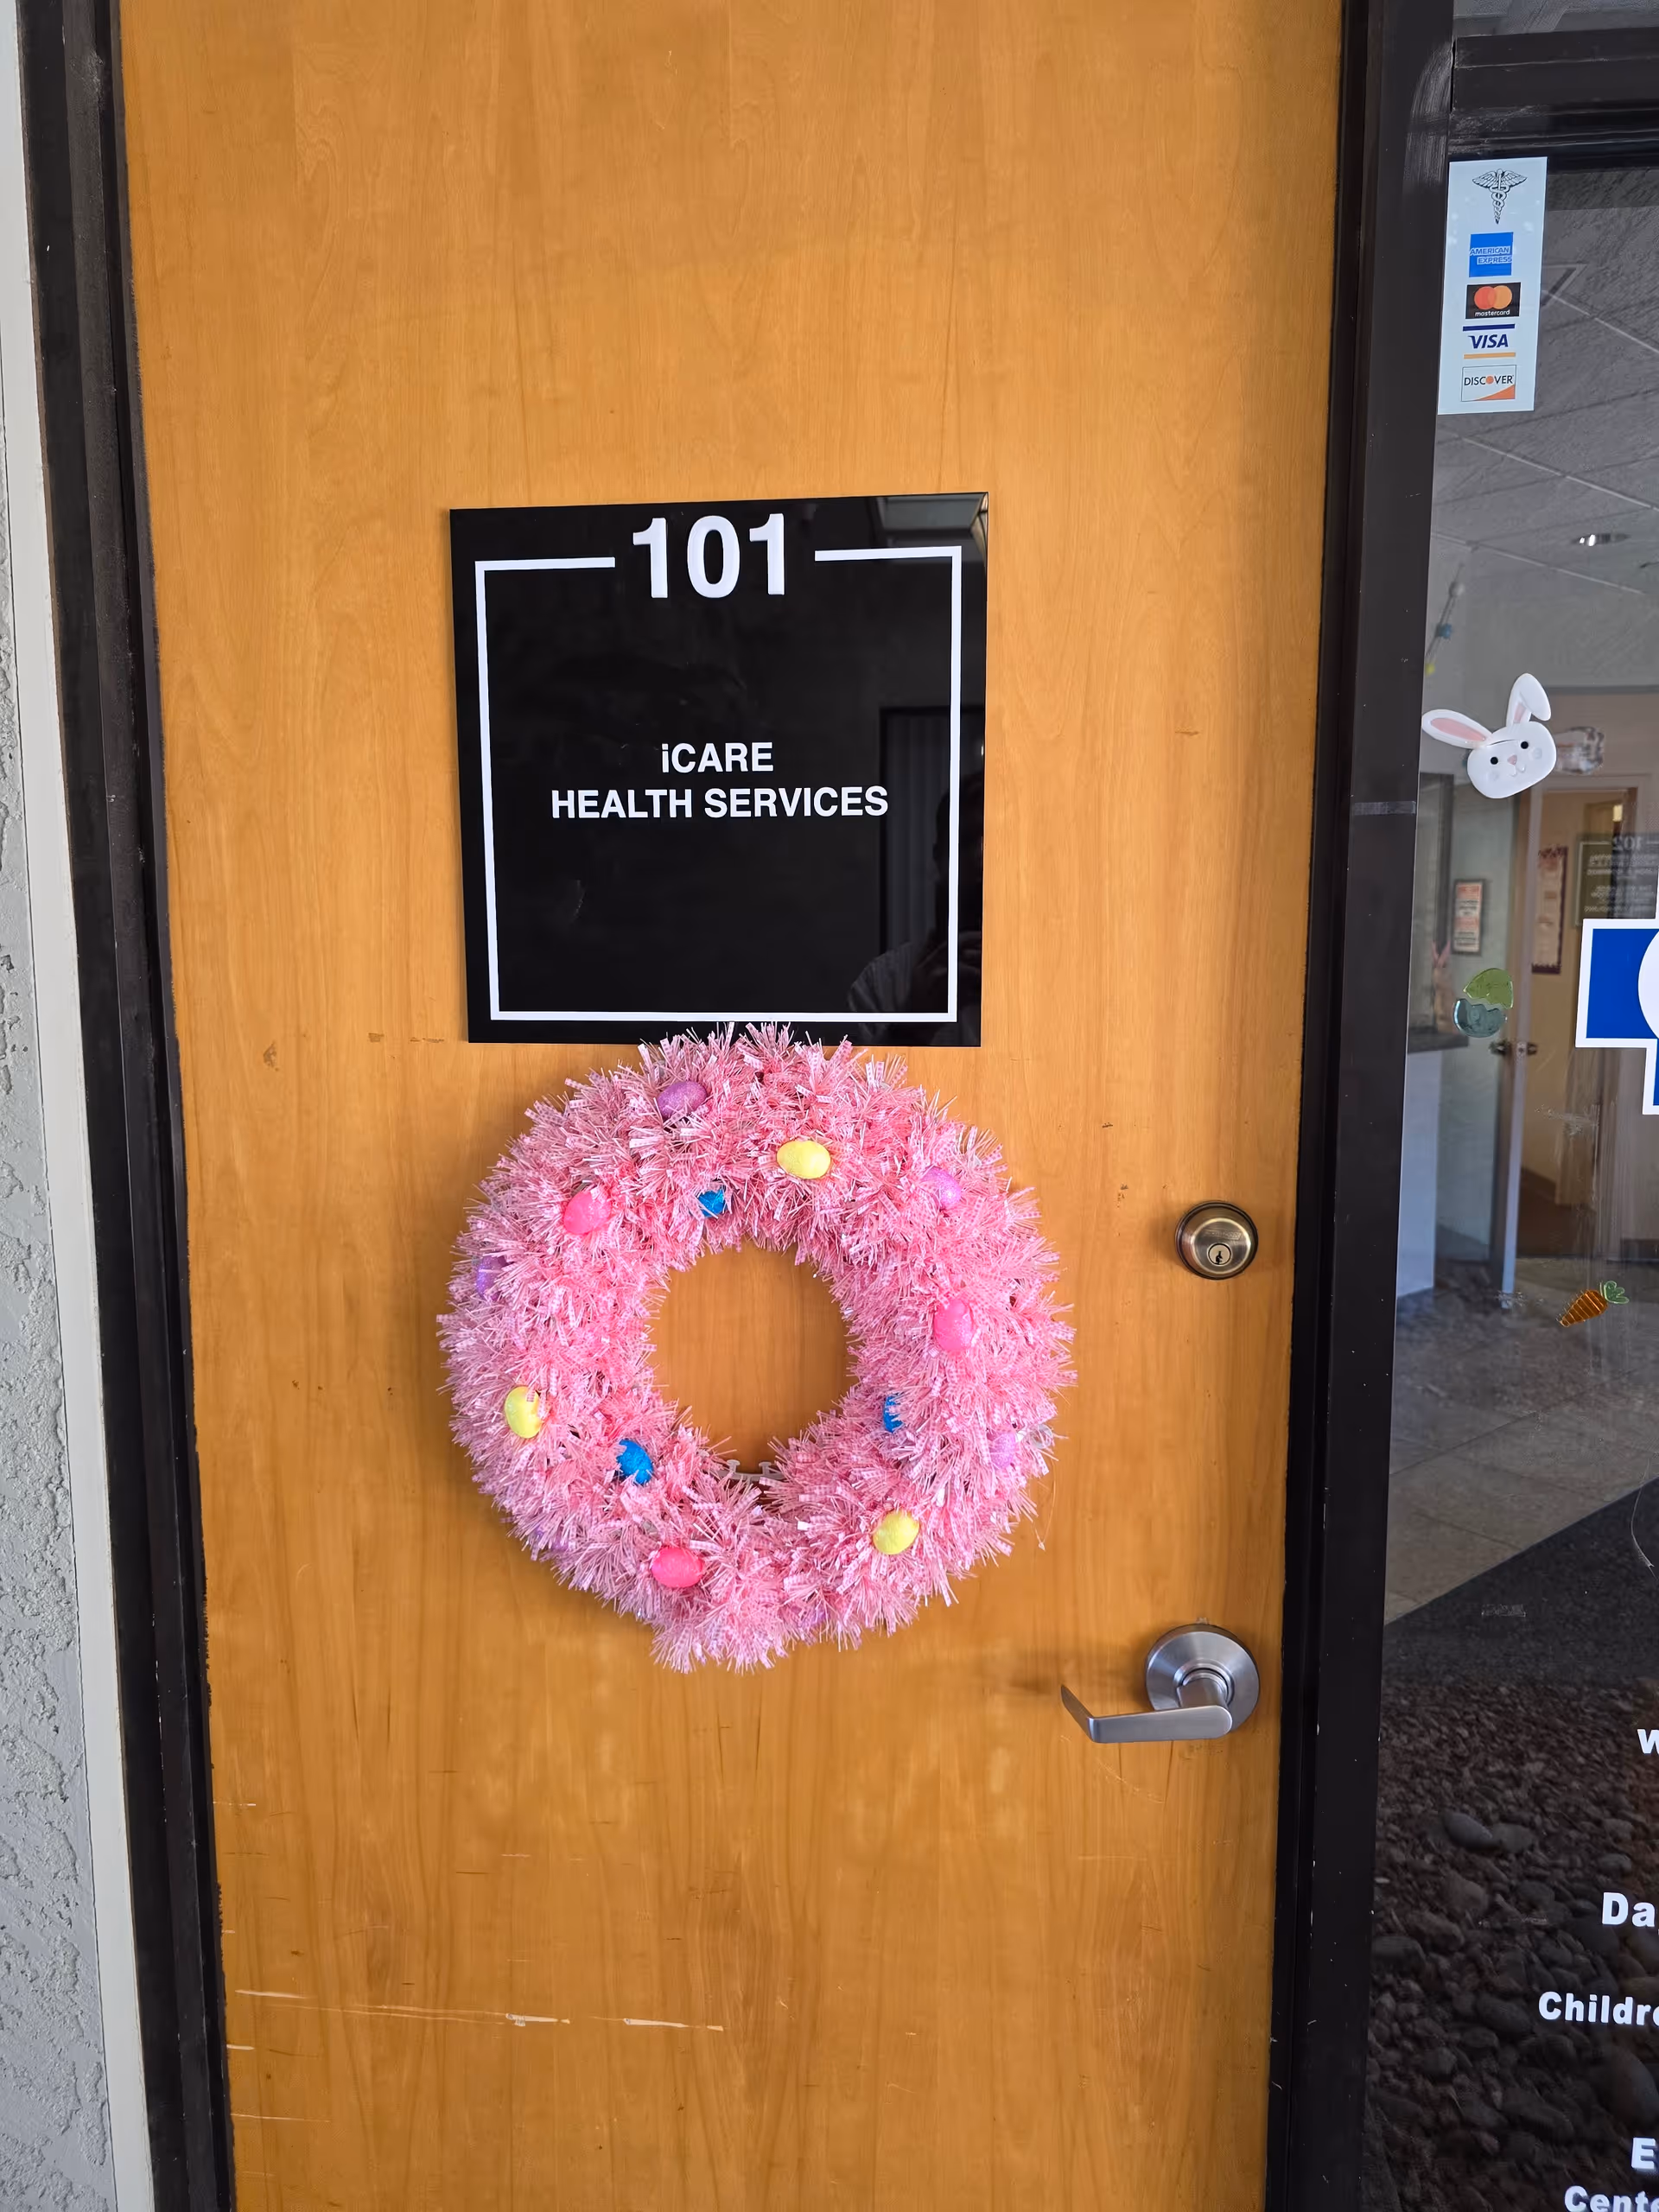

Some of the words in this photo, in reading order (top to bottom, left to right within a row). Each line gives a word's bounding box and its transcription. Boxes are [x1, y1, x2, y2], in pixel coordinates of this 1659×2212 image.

[1470, 246, 1510, 256] AMERICAN
[1477, 256, 1512, 264] EXPRESS
[1467, 334, 1509, 349] VISA
[1464, 375, 1514, 386] DISCOVER
[632, 512, 785, 599] 101
[661, 741, 774, 773] iCARE
[551, 789, 693, 820] HEALTH
[703, 785, 889, 818] SERVICES
[1601, 1891, 1659, 1936] Da
